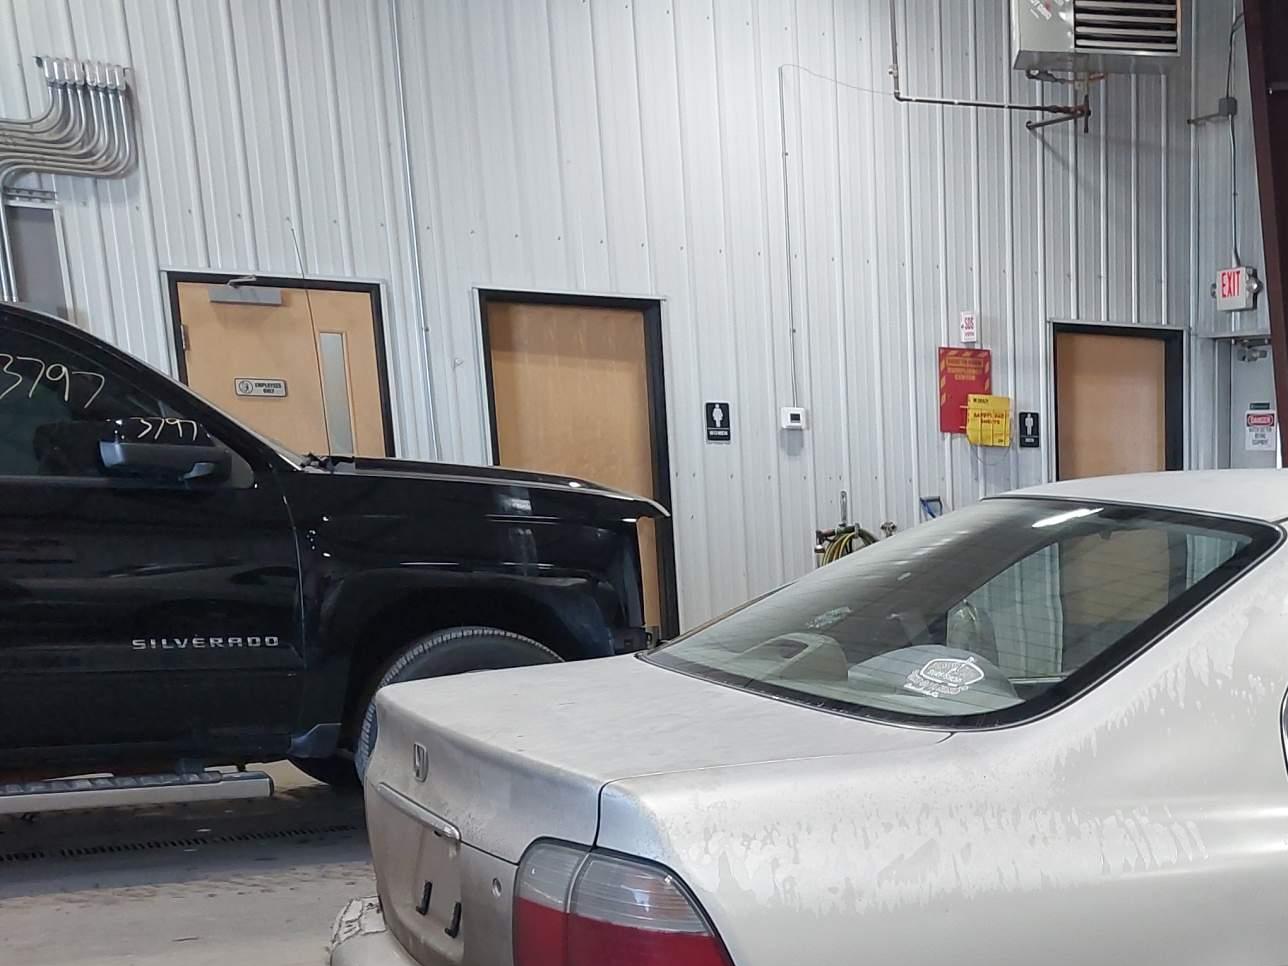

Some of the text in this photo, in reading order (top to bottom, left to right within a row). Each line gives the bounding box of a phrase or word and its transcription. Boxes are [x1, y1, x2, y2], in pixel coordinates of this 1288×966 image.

[1221, 270, 1241, 298] EXIT
[0, 353, 105, 408] 3797
[132, 636, 279, 650] SILVERADO
